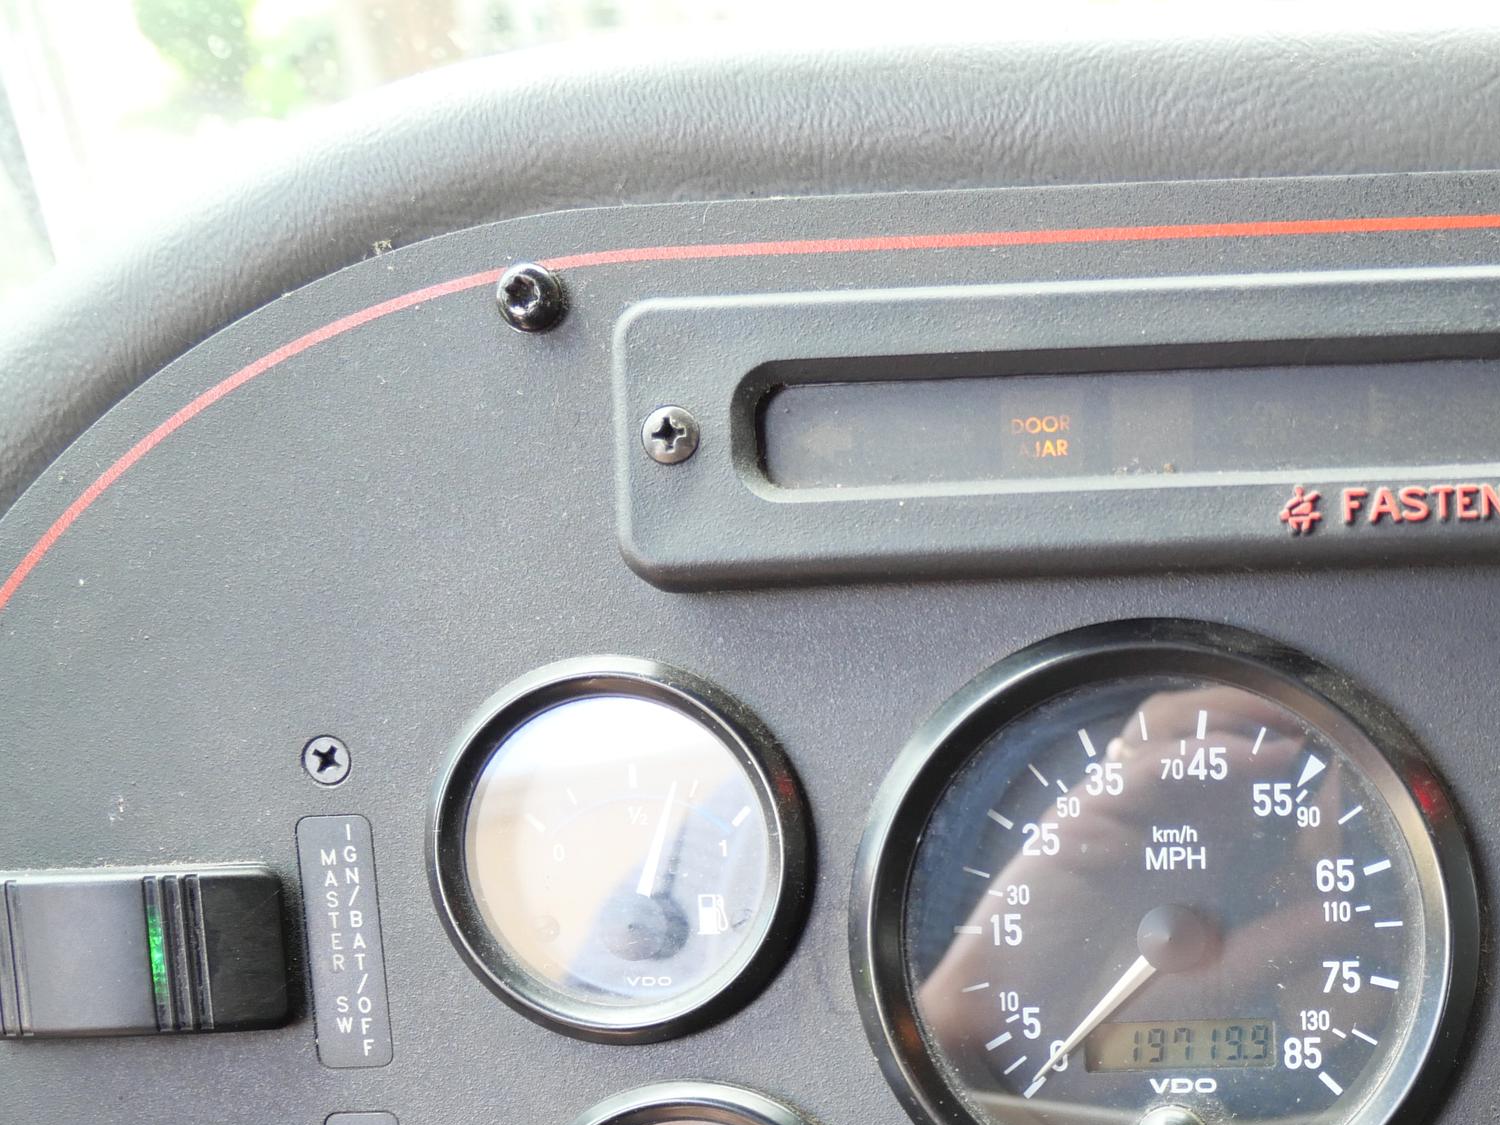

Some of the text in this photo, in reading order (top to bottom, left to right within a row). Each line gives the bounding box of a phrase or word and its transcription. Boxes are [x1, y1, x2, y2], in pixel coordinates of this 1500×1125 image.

[1011, 415, 1070, 434] DOOR
[1160, 760, 1184, 780] 70
[1188, 747, 1228, 781] 45
[1084, 762, 1124, 796] 35
[1057, 797, 1080, 818] 50
[1253, 784, 1292, 817] 55
[1297, 806, 1321, 827] 90
[1023, 823, 1060, 856] 25
[1153, 825, 1197, 843] km/h
[719, 840, 727, 857] 1
[1145, 847, 1207, 871] MPH
[1315, 859, 1355, 892] 65
[1007, 885, 1030, 905] 30
[1323, 902, 1351, 922] 110
[320, 849, 353, 1034] MASTER SW
[344, 824, 375, 1057] IGN/BAT/OFF
[990, 915, 1023, 946] 15
[627, 976, 672, 986] VDO
[1322, 961, 1361, 994] 75
[999, 992, 1019, 1012] 10
[1023, 1007, 1041, 1039] 5
[1300, 1011, 1330, 1031] 130
[1285, 1037, 1322, 1069] 85
[1150, 1078, 1217, 1093] VDO
